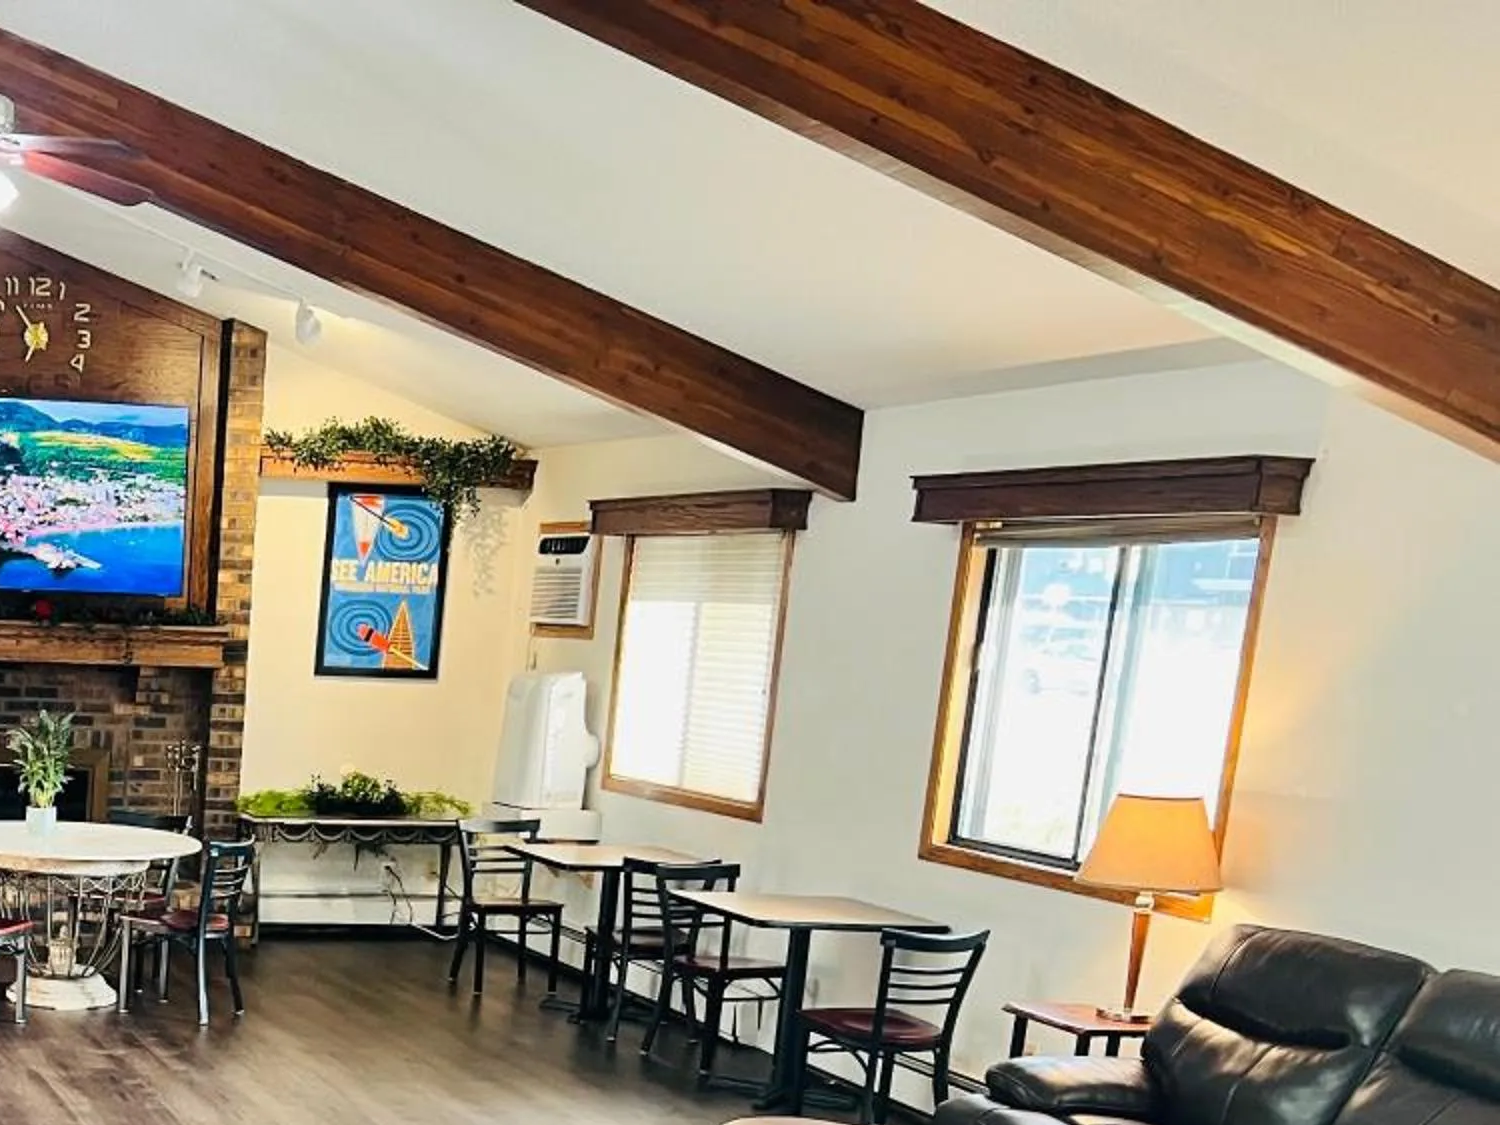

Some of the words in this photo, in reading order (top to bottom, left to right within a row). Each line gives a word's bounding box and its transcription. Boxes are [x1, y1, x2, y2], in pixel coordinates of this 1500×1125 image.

[5, 276, 19, 296] 11
[29, 276, 51, 296] 12
[59, 281, 66, 300] 1
[73, 303, 90, 322] 2
[77, 329, 90, 348] 3
[70, 353, 85, 373] 4
[330, 558, 358, 582] SEE
[364, 560, 438, 585] AMERICA
